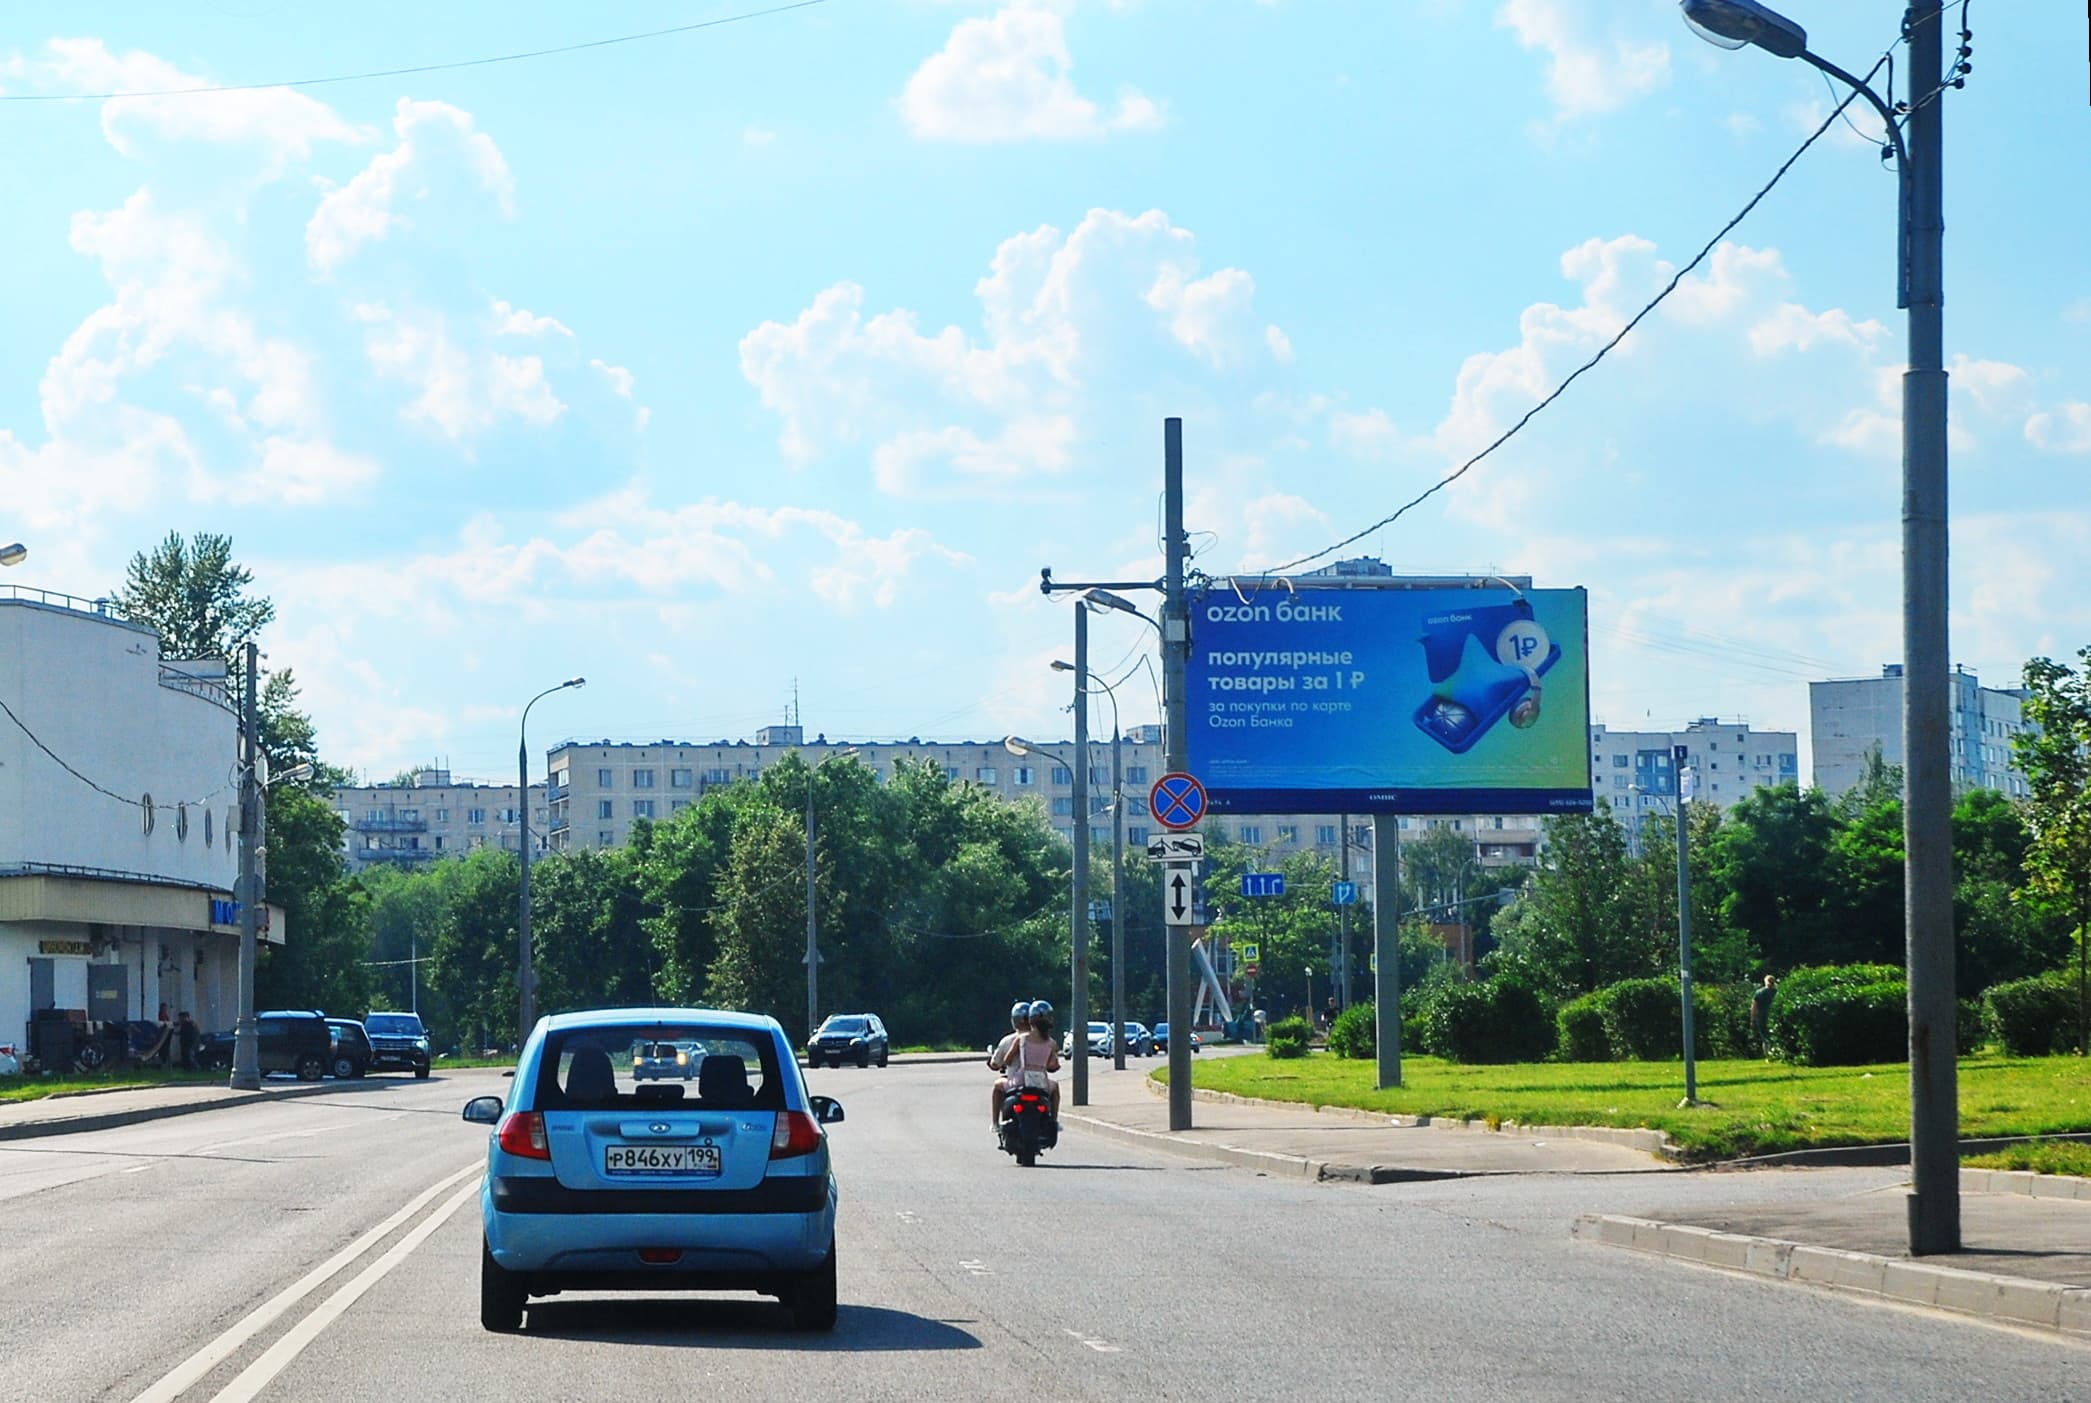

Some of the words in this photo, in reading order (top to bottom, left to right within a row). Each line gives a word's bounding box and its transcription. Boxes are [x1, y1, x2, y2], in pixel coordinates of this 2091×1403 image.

[1207, 605, 1270, 622] ozon
[1276, 601, 1343, 622] банк
[1208, 651, 1353, 670] популярные
[1208, 676, 1295, 695] товары
[1302, 676, 1328, 690] за
[1208, 702, 1225, 712] за
[1229, 702, 1287, 714] покупки
[1291, 702, 1308, 712] по
[1312, 701, 1352, 714] карте
[1208, 715, 1246, 728] Ozon
[1250, 714, 1293, 728] Банка
[687, 1148, 714, 1163] 199
